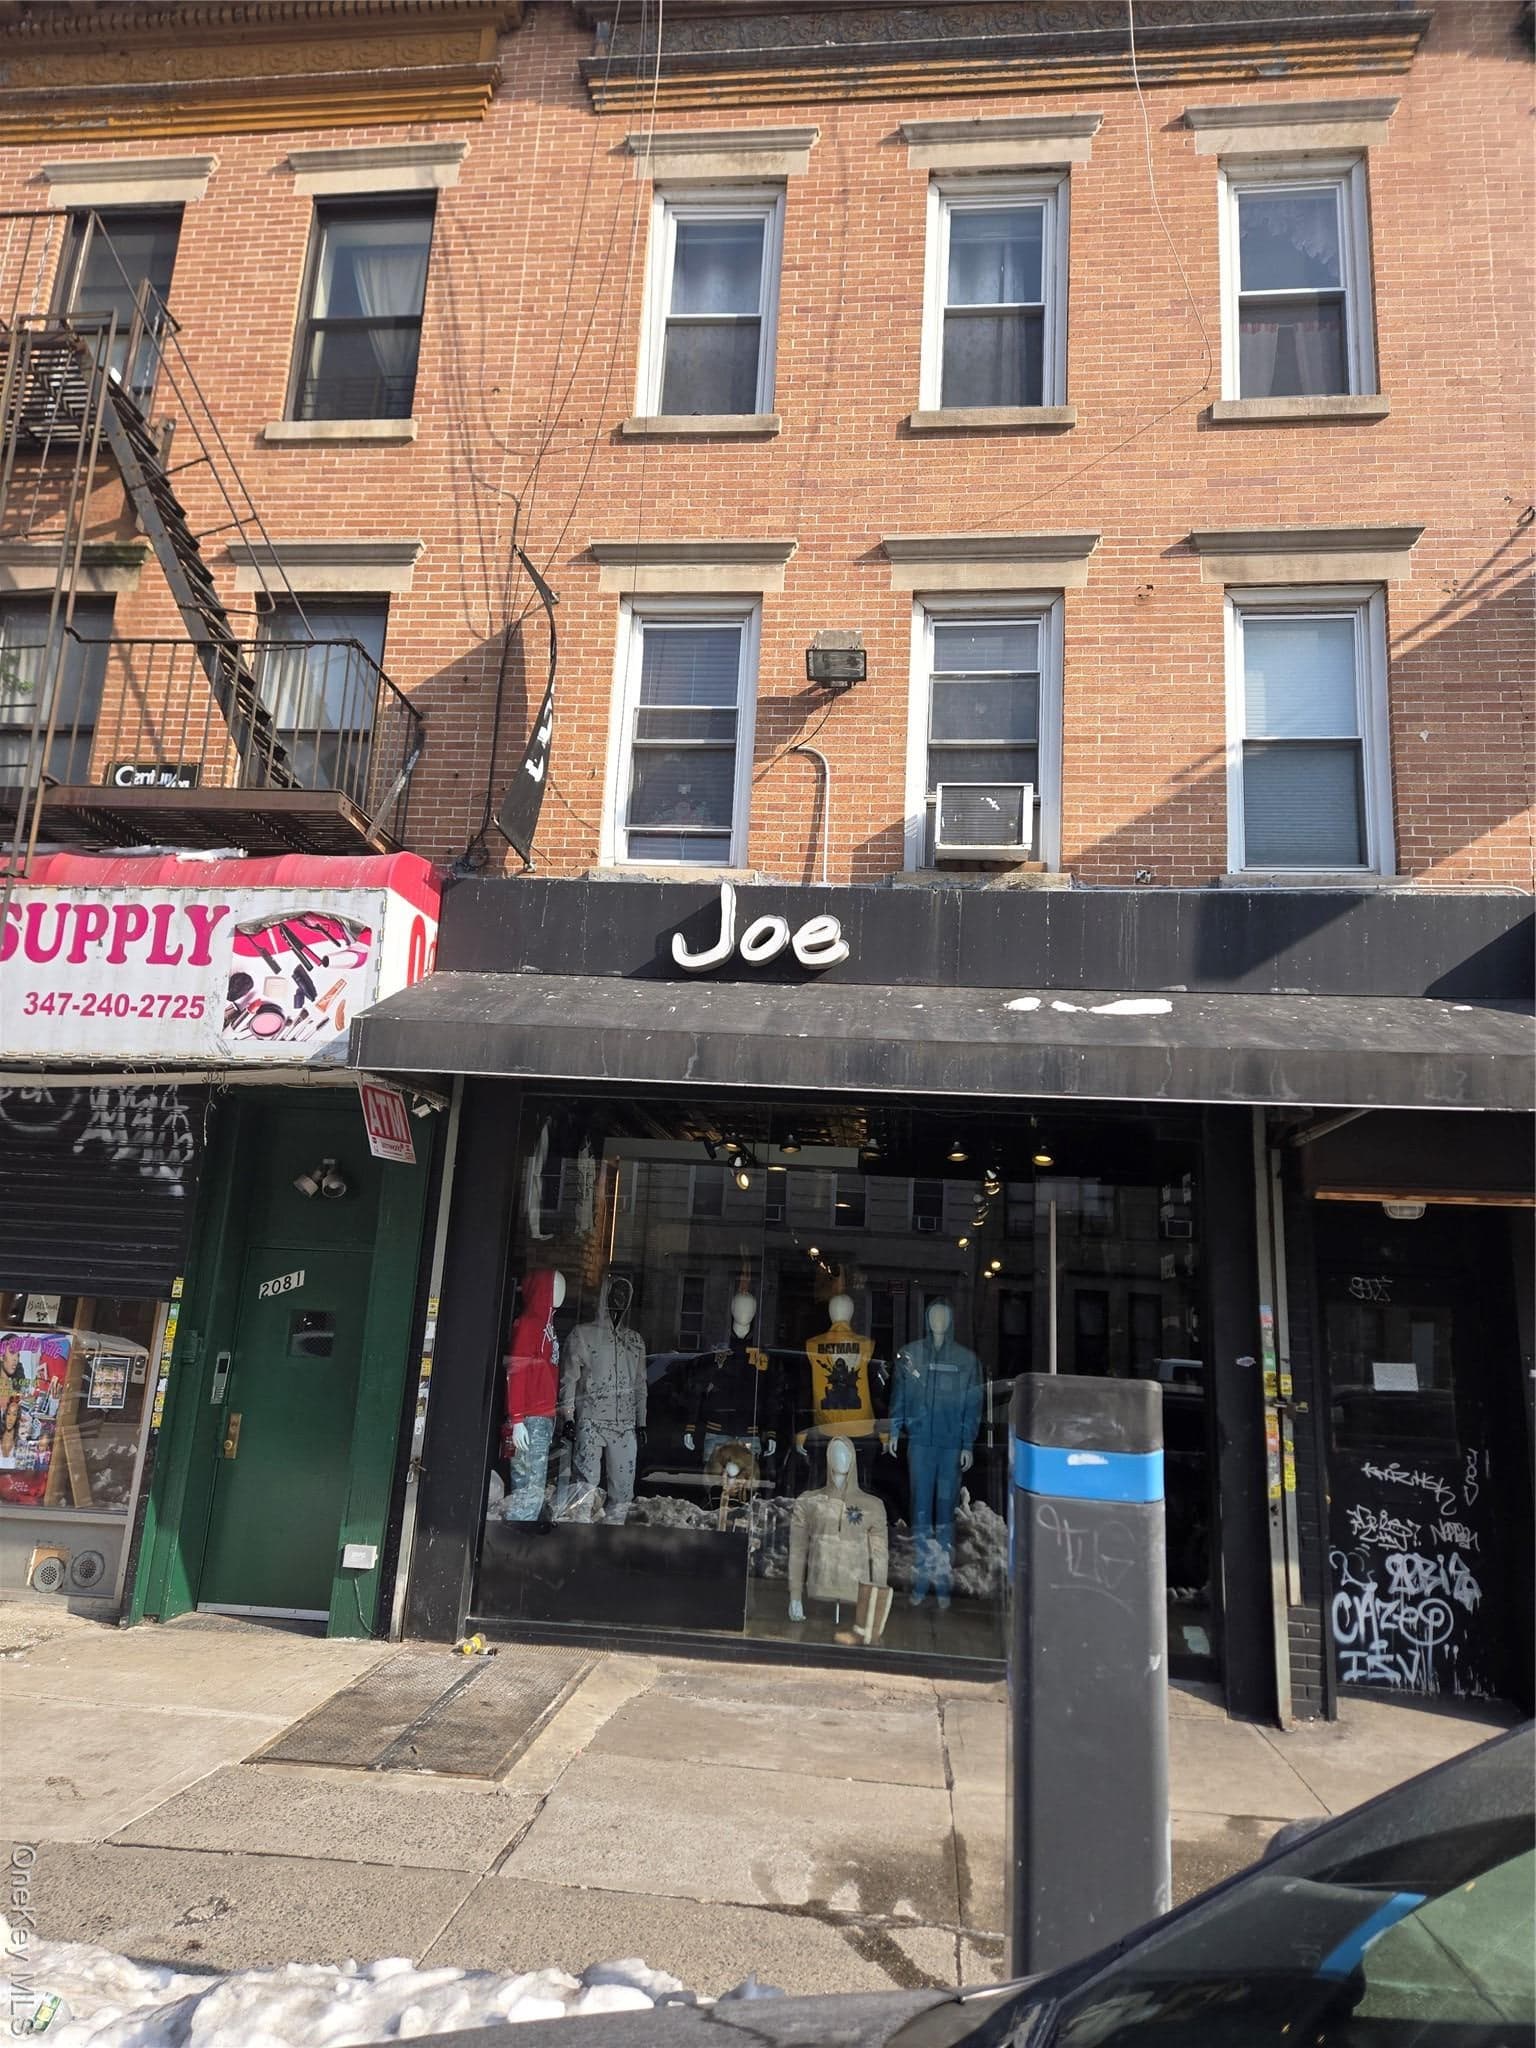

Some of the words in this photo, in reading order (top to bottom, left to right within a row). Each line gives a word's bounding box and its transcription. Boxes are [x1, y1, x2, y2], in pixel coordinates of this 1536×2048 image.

[672, 881, 849, 973] Joe
[23, 991, 206, 1019] 347-240-2725
[366, 1087, 408, 1142] ATM
[261, 1271, 301, 1298] 2081
